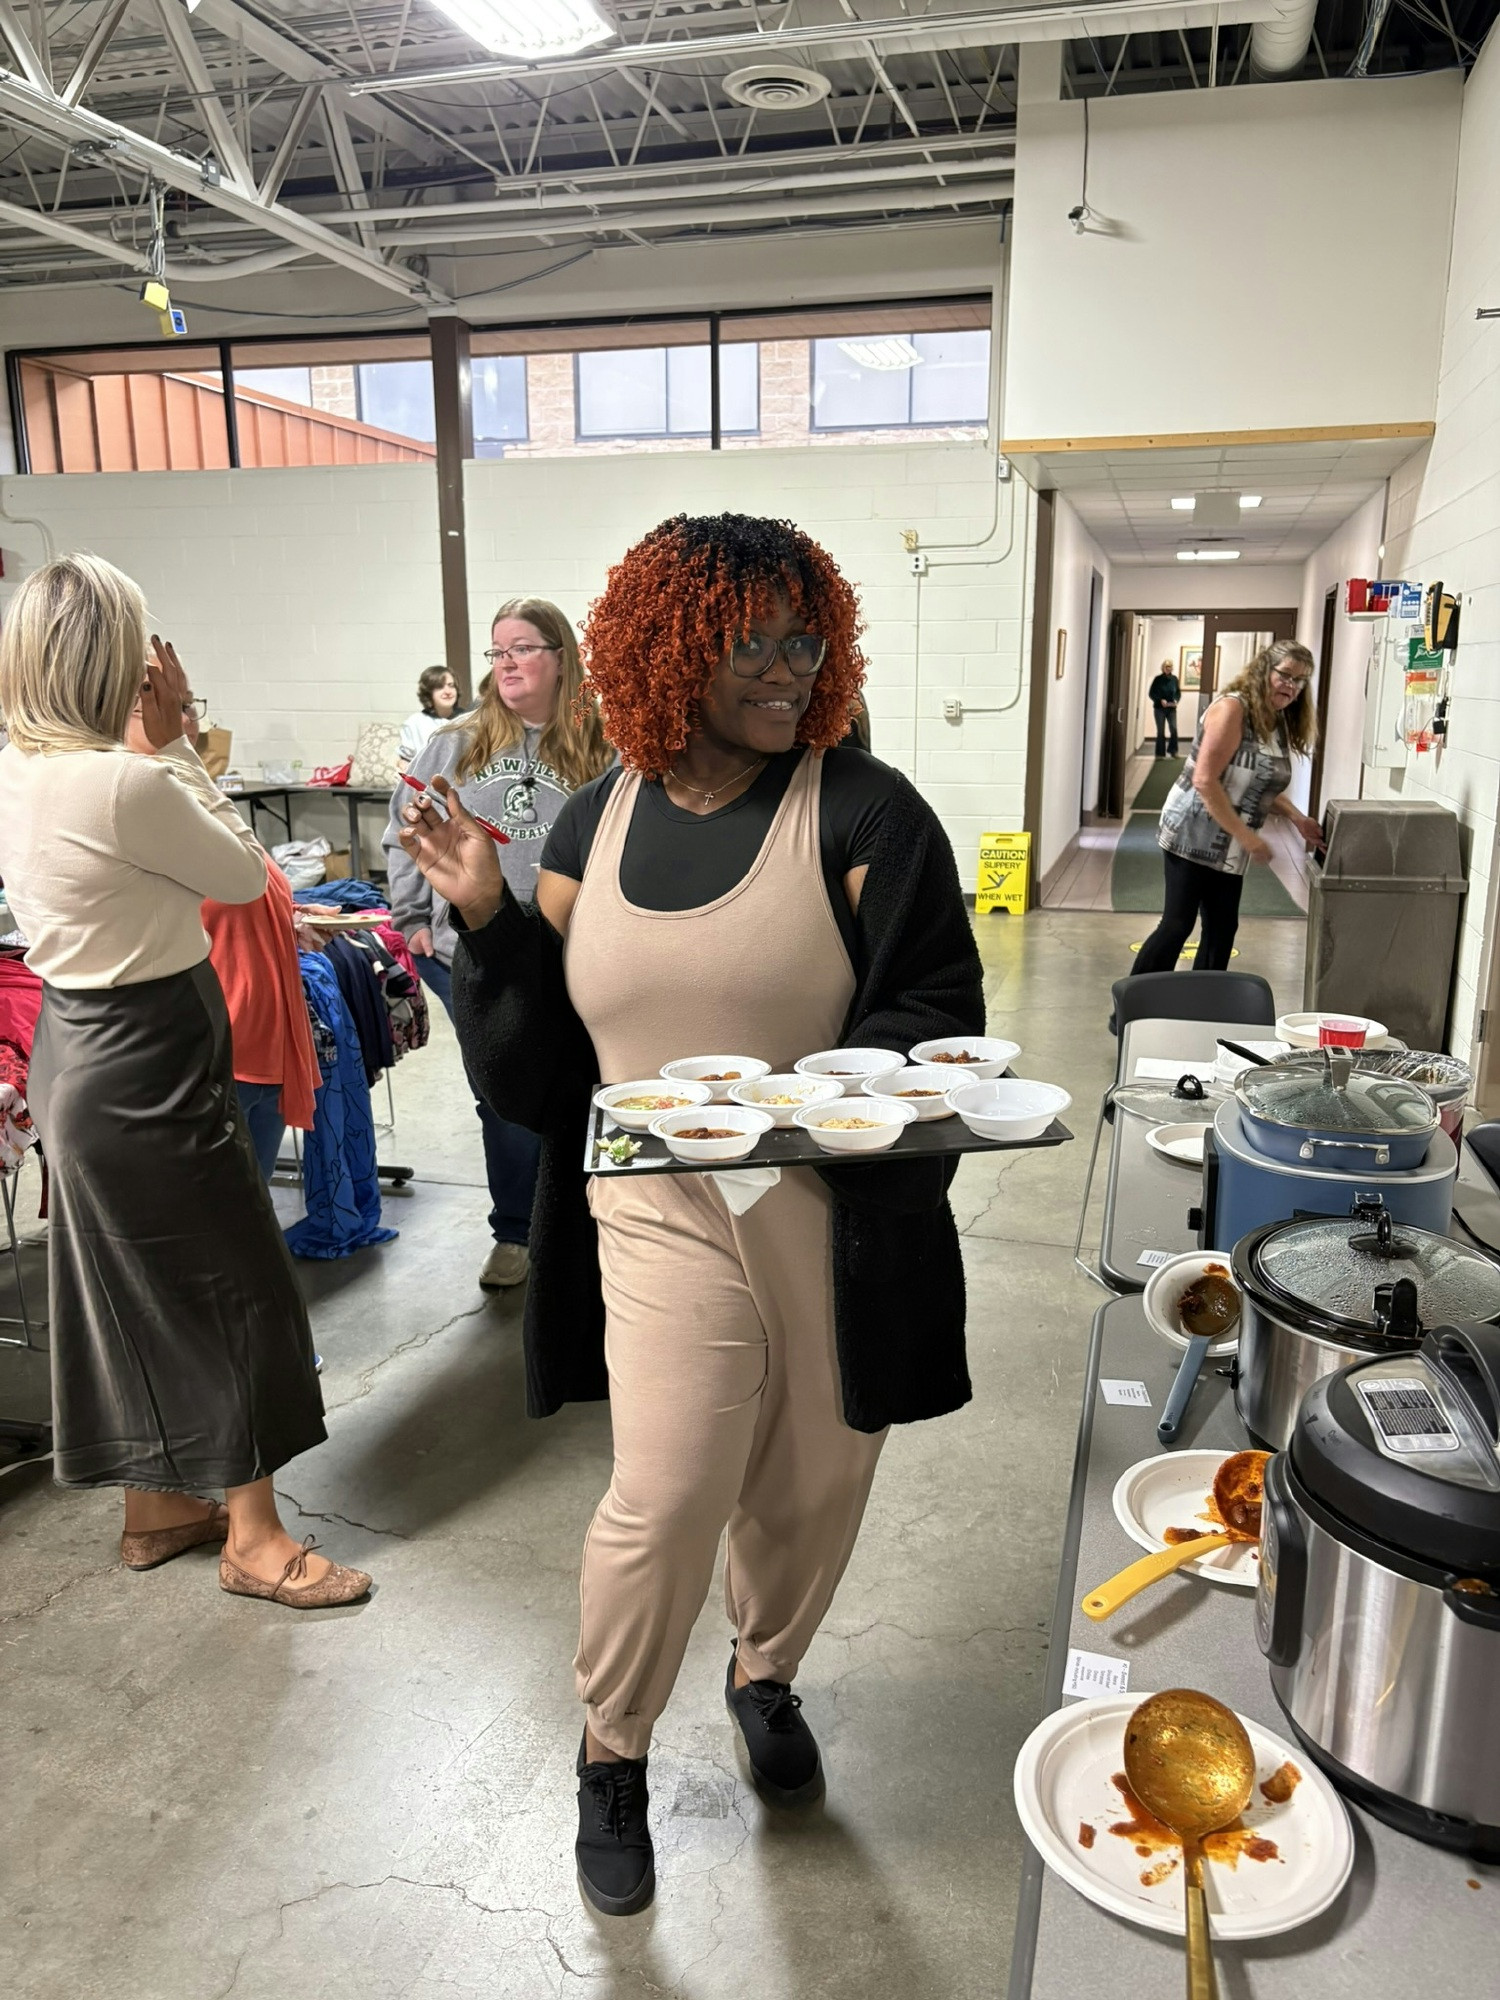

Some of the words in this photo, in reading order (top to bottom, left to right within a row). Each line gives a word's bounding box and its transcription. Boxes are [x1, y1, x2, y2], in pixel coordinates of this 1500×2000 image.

[475, 757, 571, 790] NEWFIE
[982, 850, 1025, 859] CAUTION
[984, 861, 1021, 869] SLIPPERY
[978, 893, 1001, 901] WHEN
